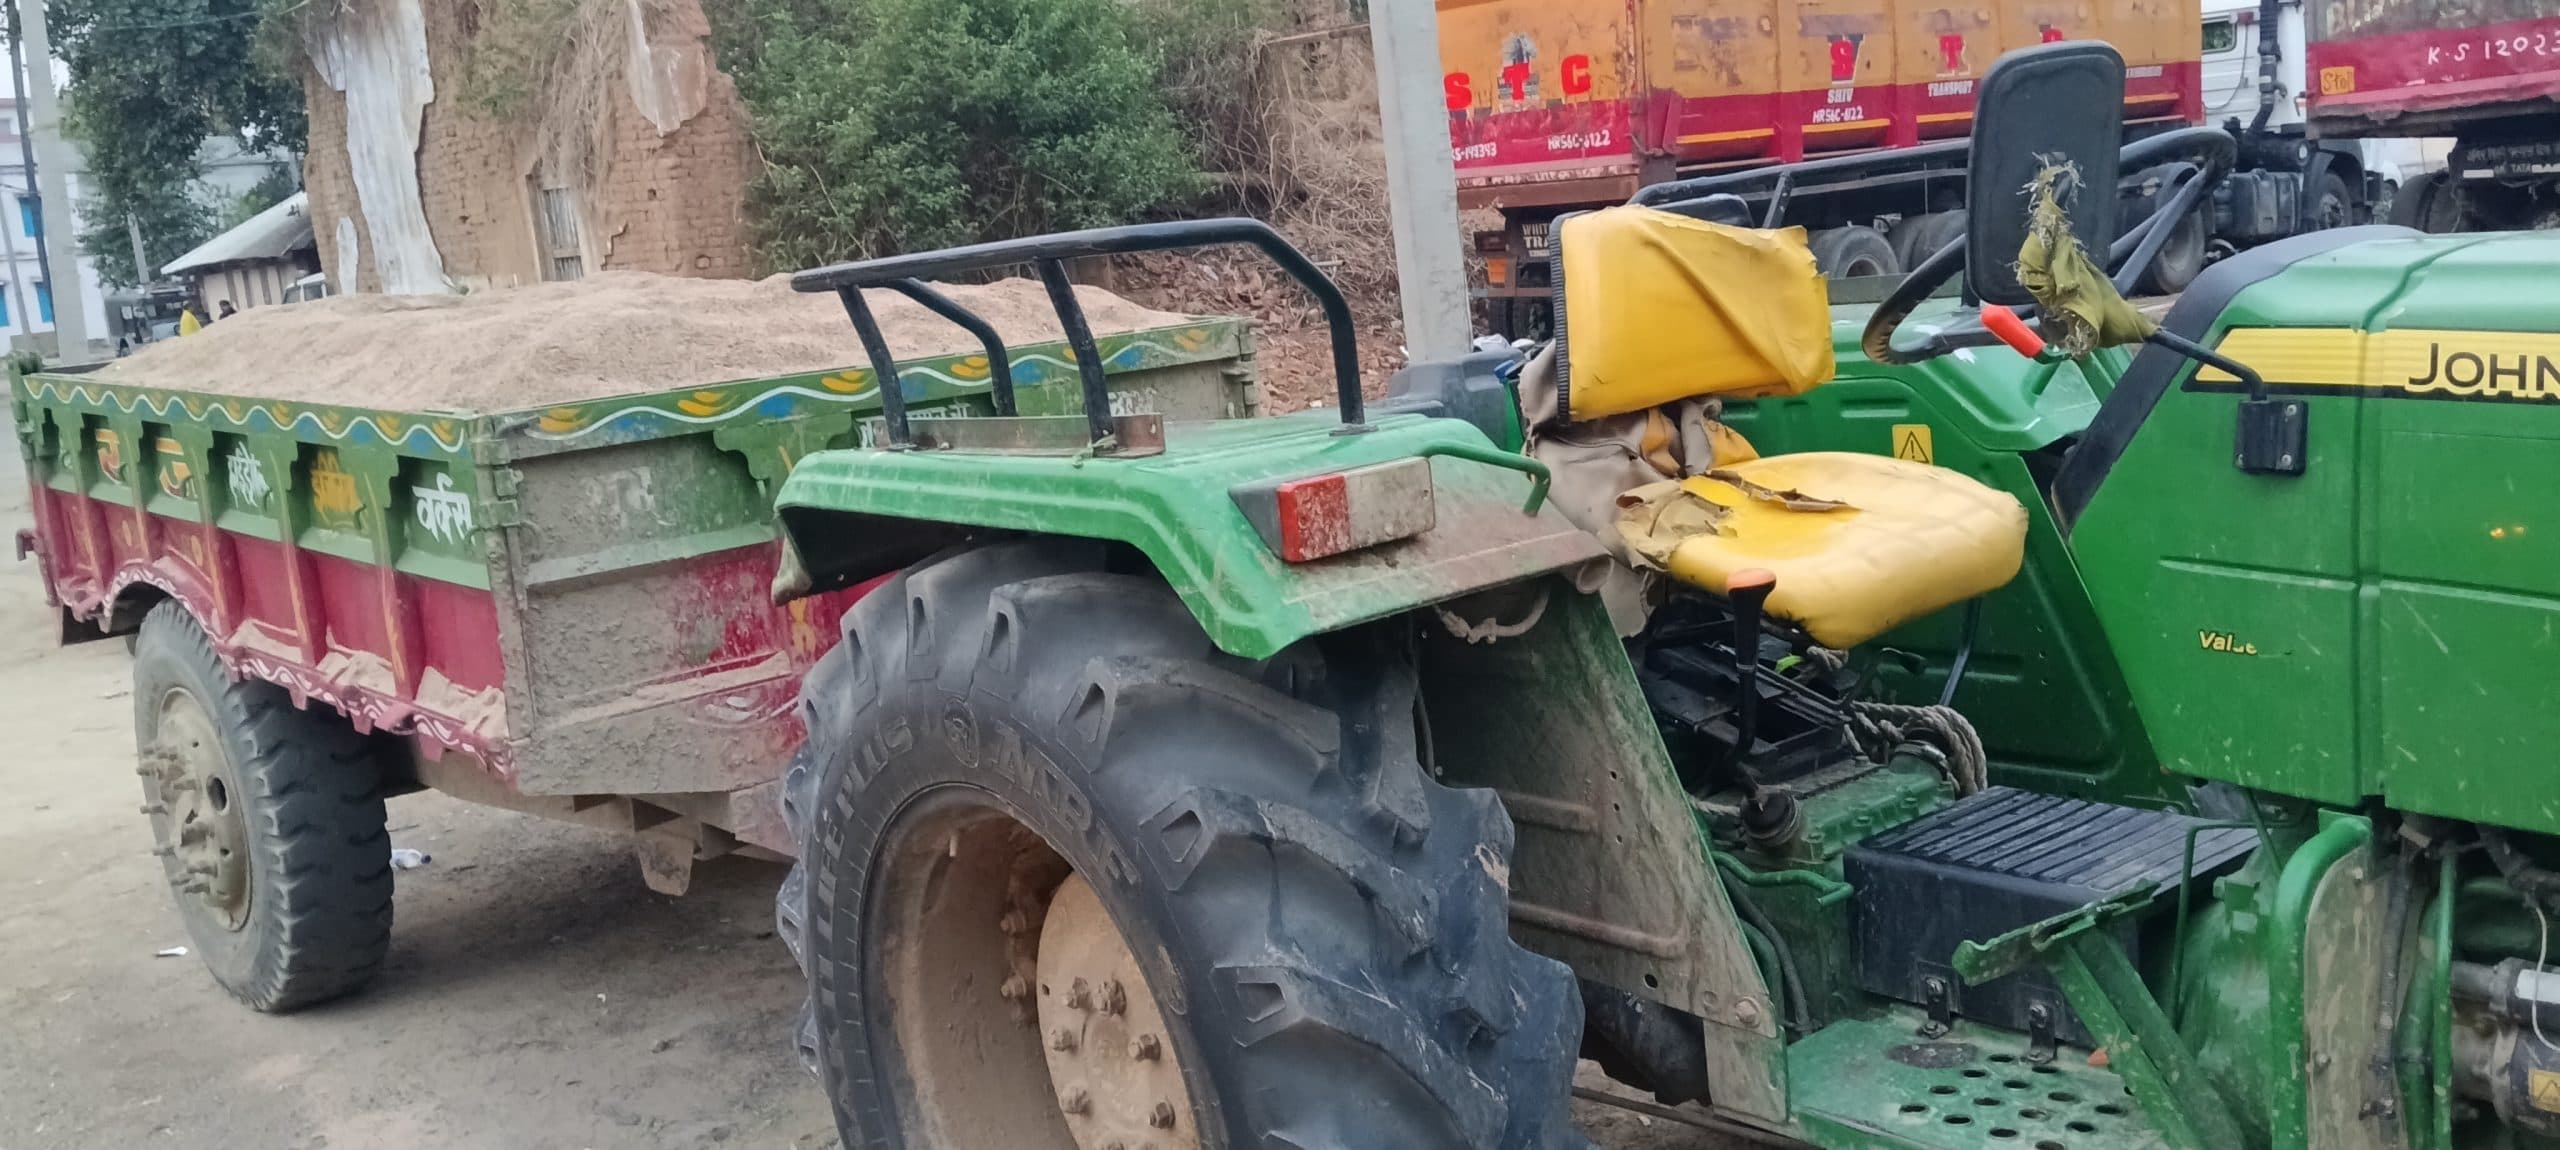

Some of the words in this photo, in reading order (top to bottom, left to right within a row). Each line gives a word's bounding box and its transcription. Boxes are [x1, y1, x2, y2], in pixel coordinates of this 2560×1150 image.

[1444, 72, 1472, 110] S
[1503, 61, 1530, 101] T
[1561, 54, 1591, 95] C
